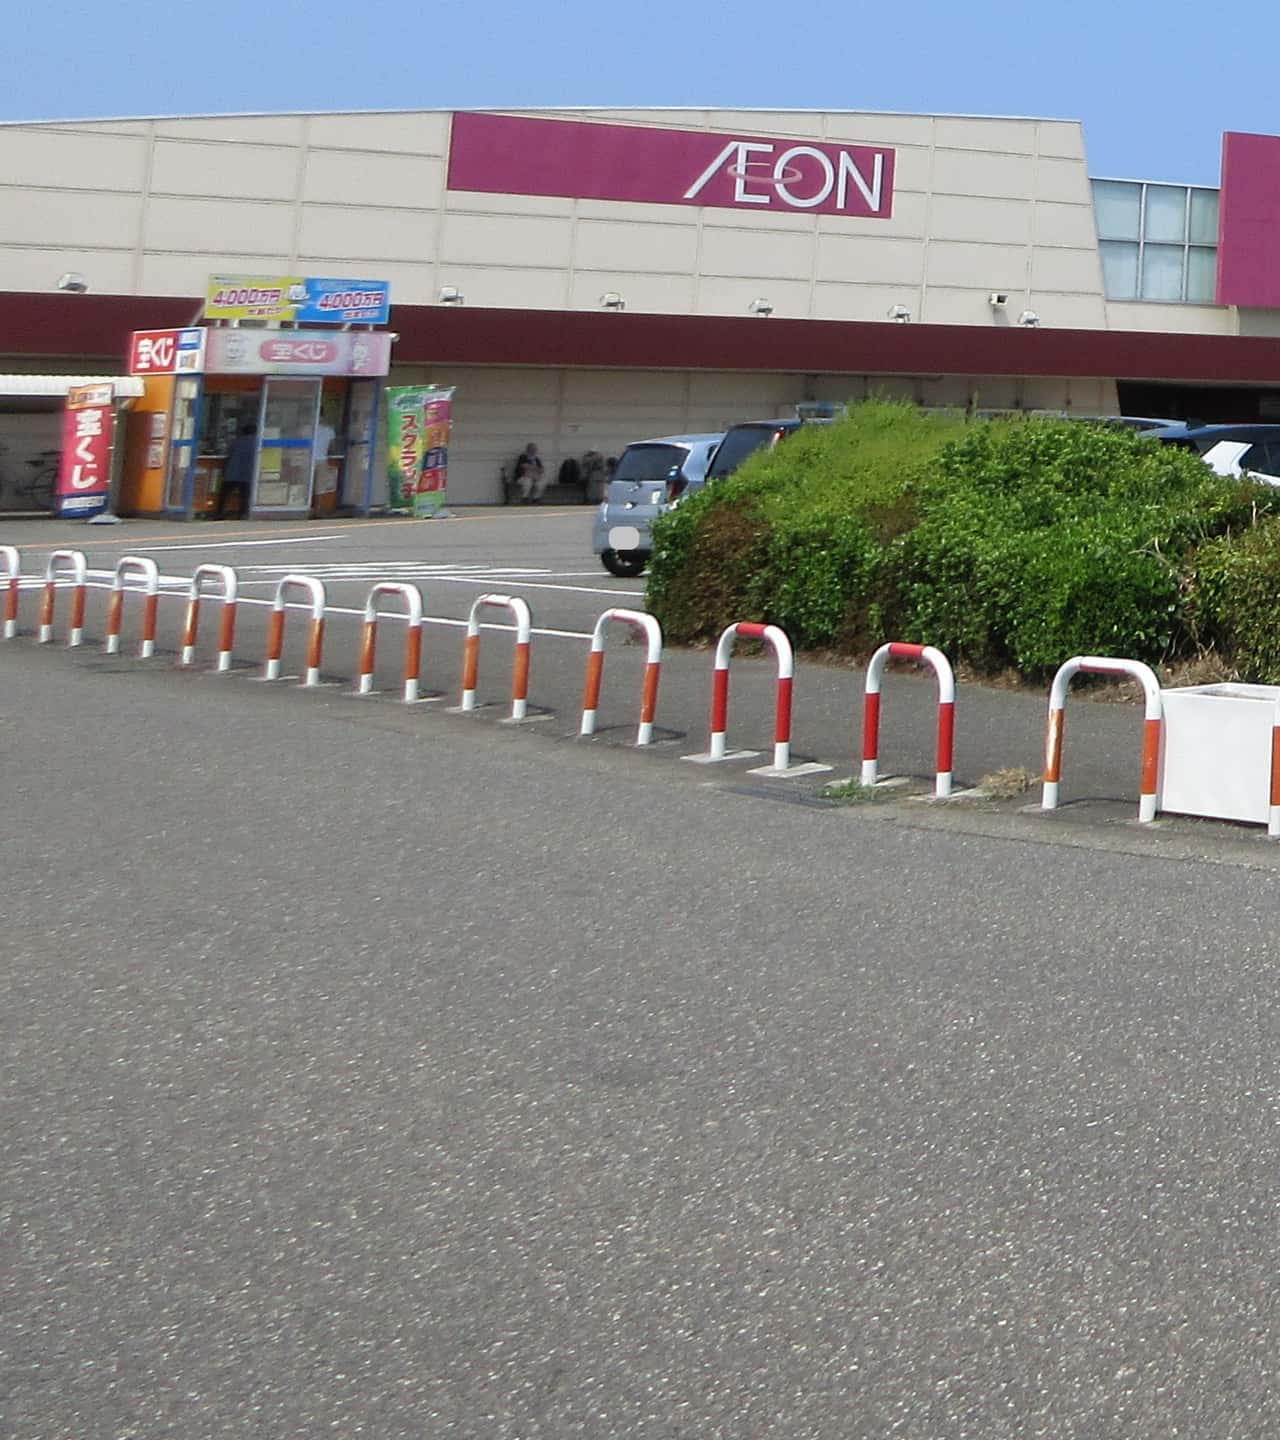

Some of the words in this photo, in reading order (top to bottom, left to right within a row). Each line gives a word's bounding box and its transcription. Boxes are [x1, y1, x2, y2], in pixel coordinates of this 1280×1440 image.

[136, 336, 176, 369] 宝くじ
[271, 342, 329, 361] 宝くじ
[71, 410, 103, 490] 宝くじ
